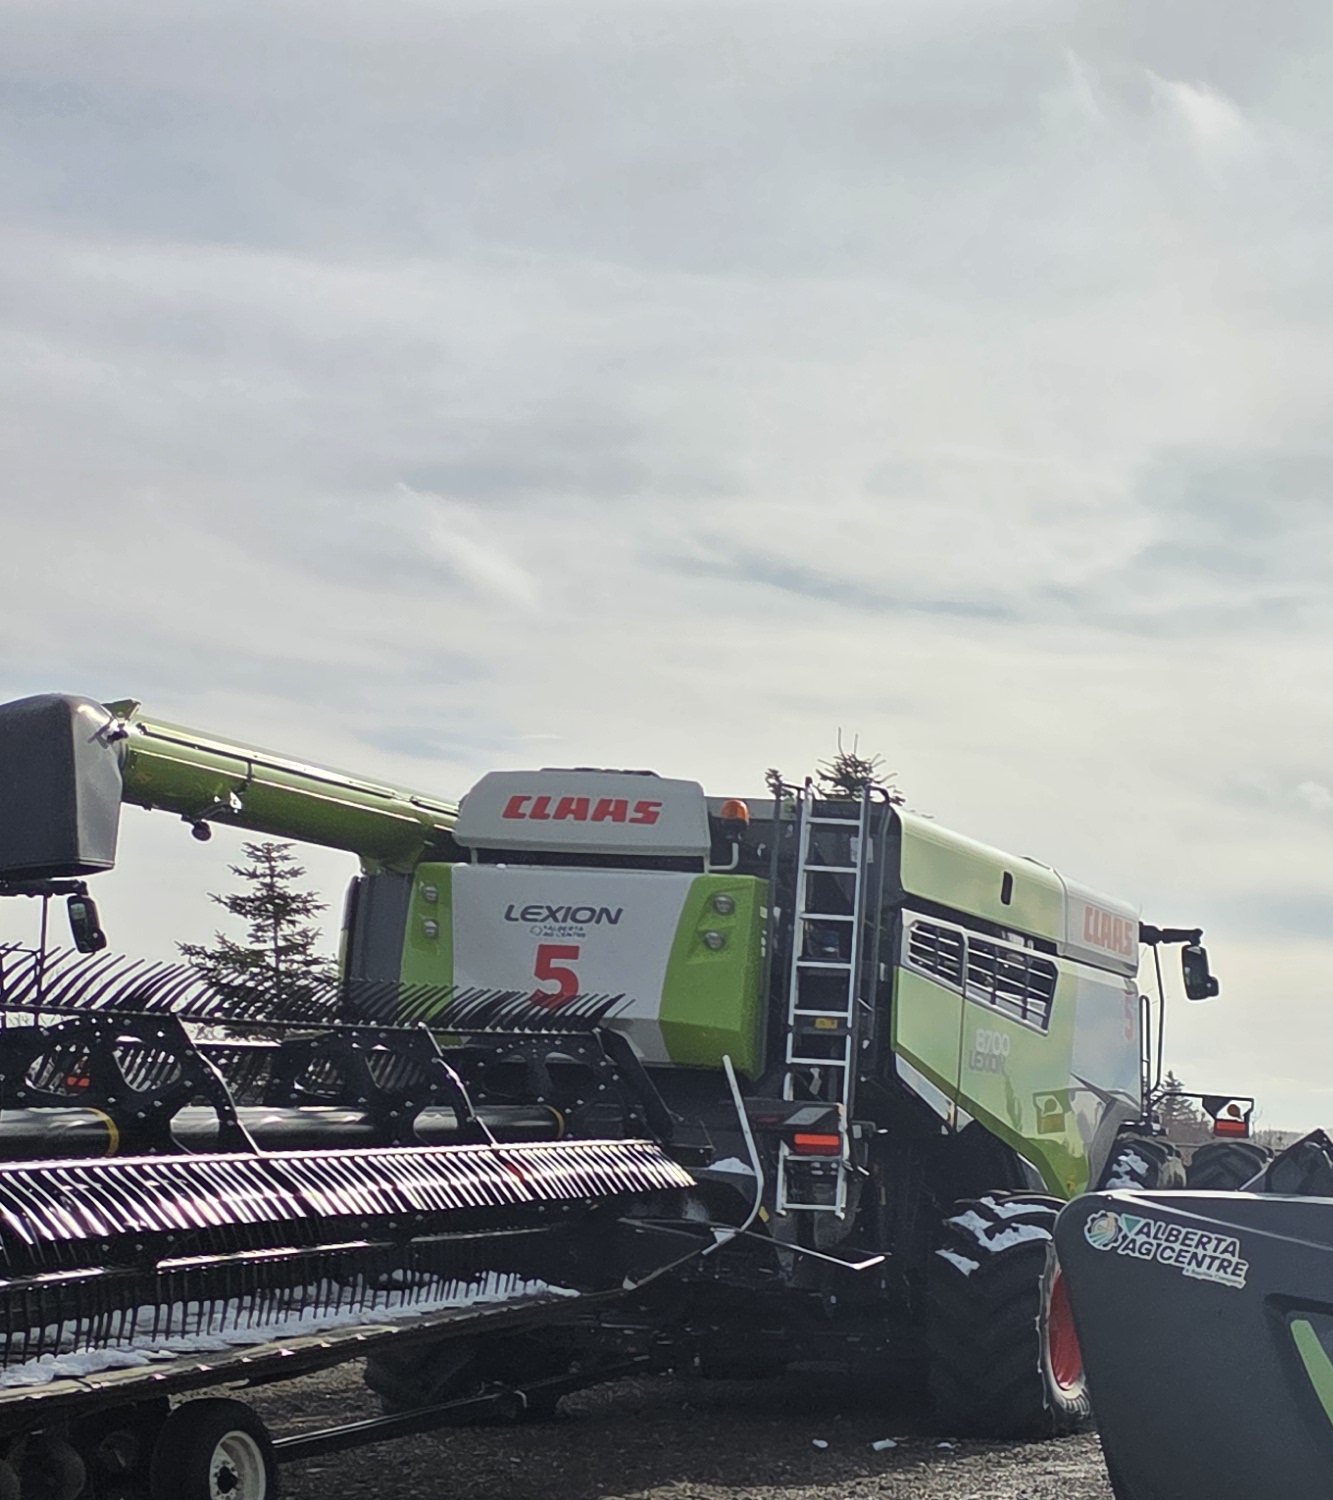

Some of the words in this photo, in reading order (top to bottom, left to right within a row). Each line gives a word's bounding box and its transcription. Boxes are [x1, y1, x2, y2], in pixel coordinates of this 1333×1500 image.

[502, 795, 662, 825] CLAAS
[504, 904, 623, 924] LEXION
[1083, 906, 1133, 956] CLAAS
[529, 944, 580, 1012] 5
[976, 1028, 1010, 1057] 8700
[1133, 1221, 1239, 1257] ALBERTA
[1120, 1238, 1152, 1257] AG
[1159, 1245, 1247, 1278] CENTRE
